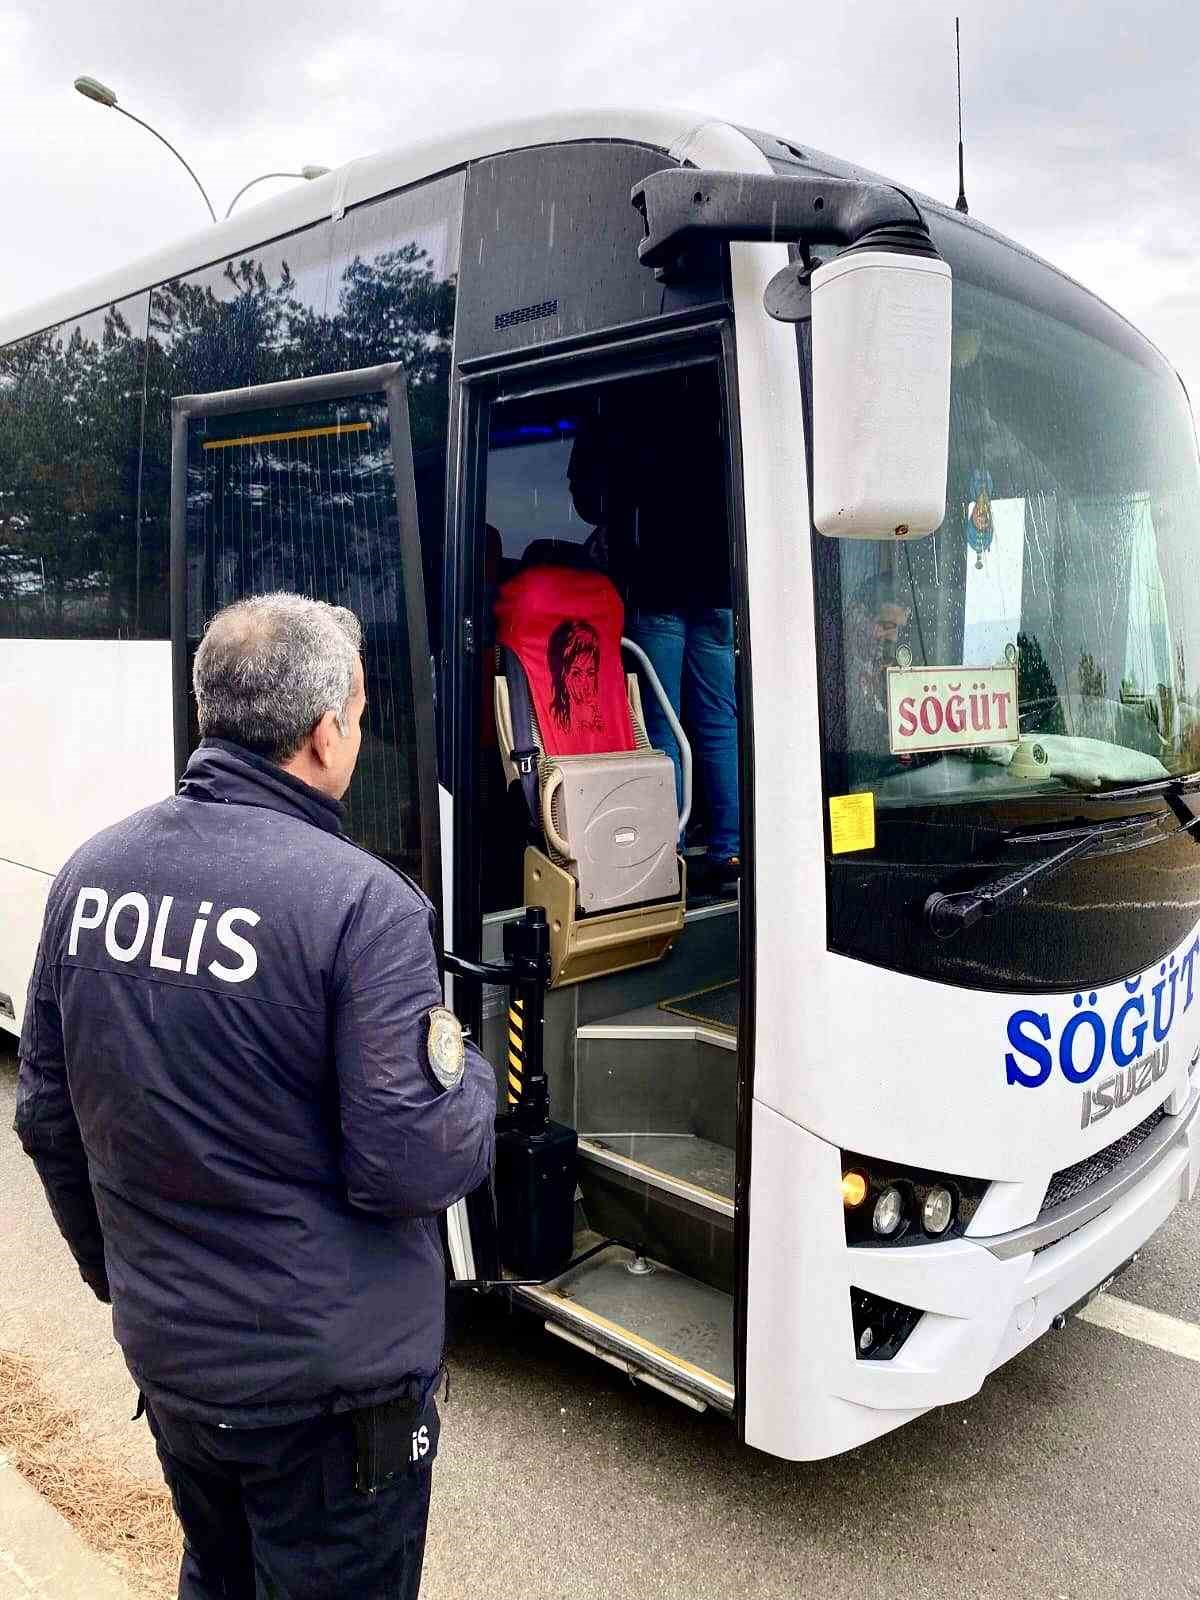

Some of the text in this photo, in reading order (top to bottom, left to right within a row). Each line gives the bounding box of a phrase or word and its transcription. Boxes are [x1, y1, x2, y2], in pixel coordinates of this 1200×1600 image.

[898, 682, 1011, 737] SÖĞÜT
[1005, 935, 1200, 1088] SÖĞÜT
[1081, 1041, 1170, 1130] ISUZU
